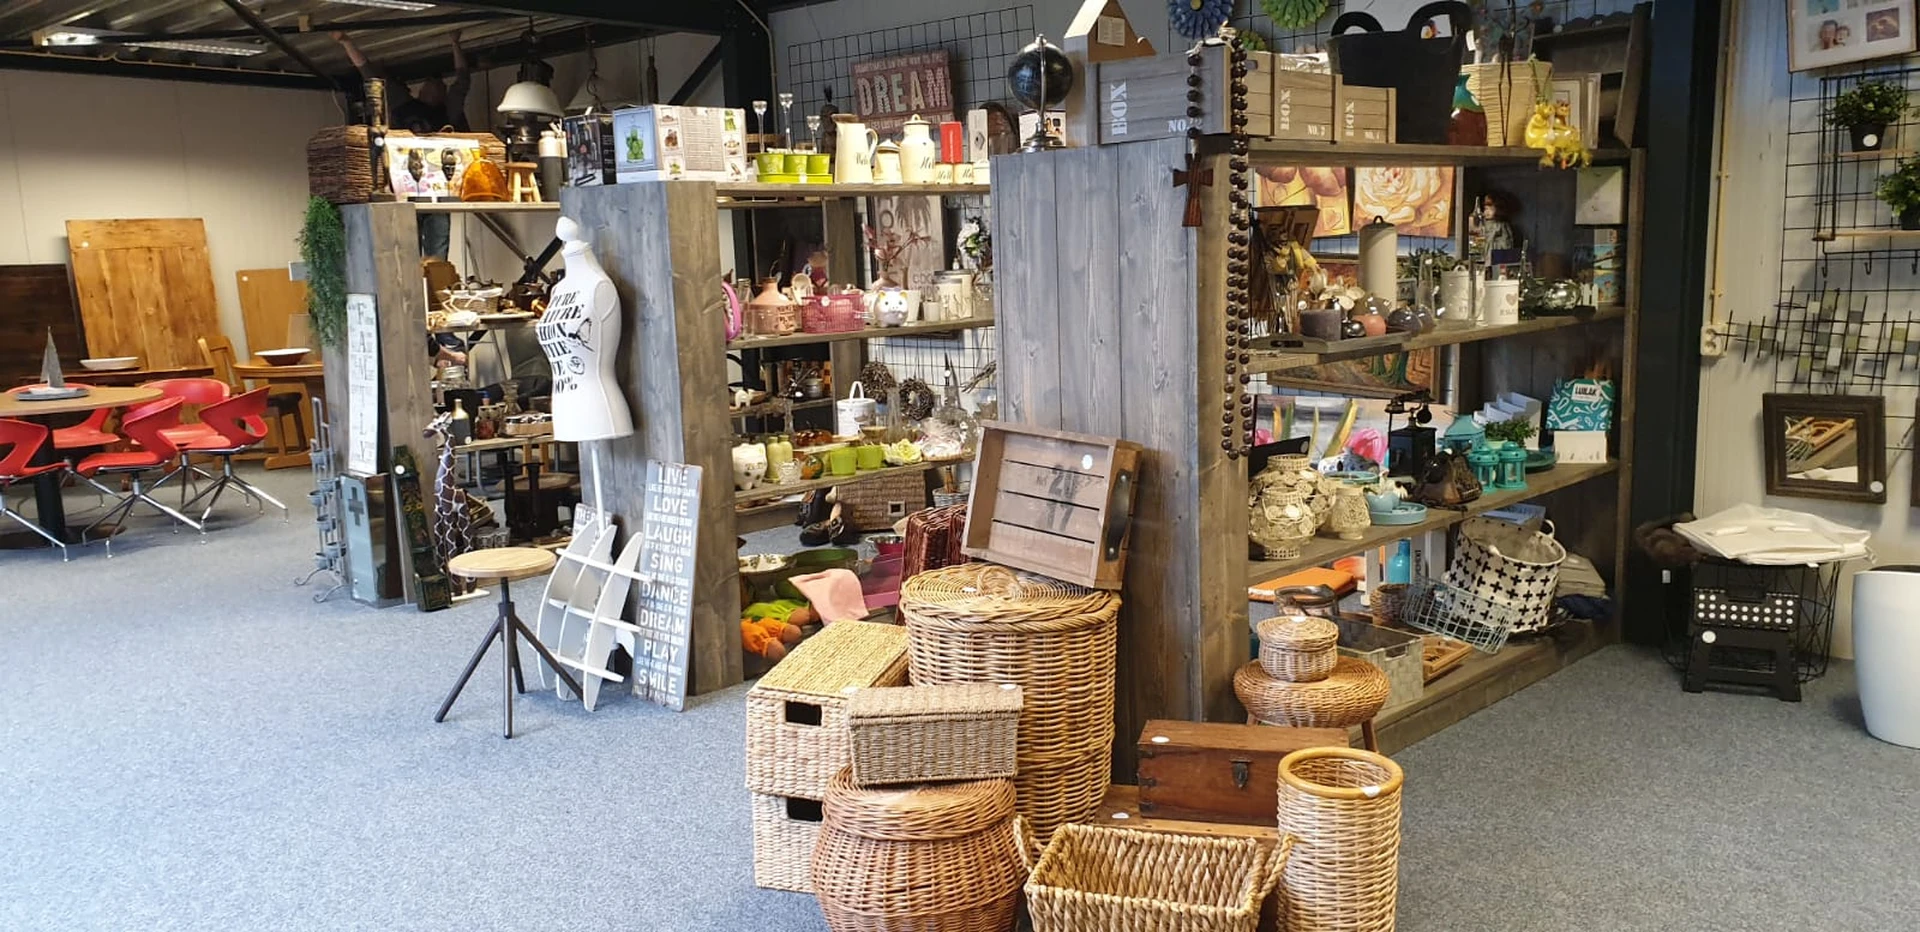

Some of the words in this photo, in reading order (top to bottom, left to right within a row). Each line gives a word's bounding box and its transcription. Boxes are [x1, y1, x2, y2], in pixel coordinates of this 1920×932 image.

[857, 67, 947, 116] DREAM
[1110, 81, 1128, 136] BOX
[1280, 89, 1291, 131] BOX
[1345, 101, 1355, 136] BOX
[549, 290, 577, 309] PURE
[658, 467, 689, 486] LIVE
[653, 495, 688, 515] LOVE
[646, 523, 692, 546] LAUGH
[650, 552, 684, 573] SING
[642, 582, 688, 606] DANCE
[640, 609, 684, 635] DREAM
[644, 639, 678, 663] PLAY
[638, 669, 676, 694] SMILE
